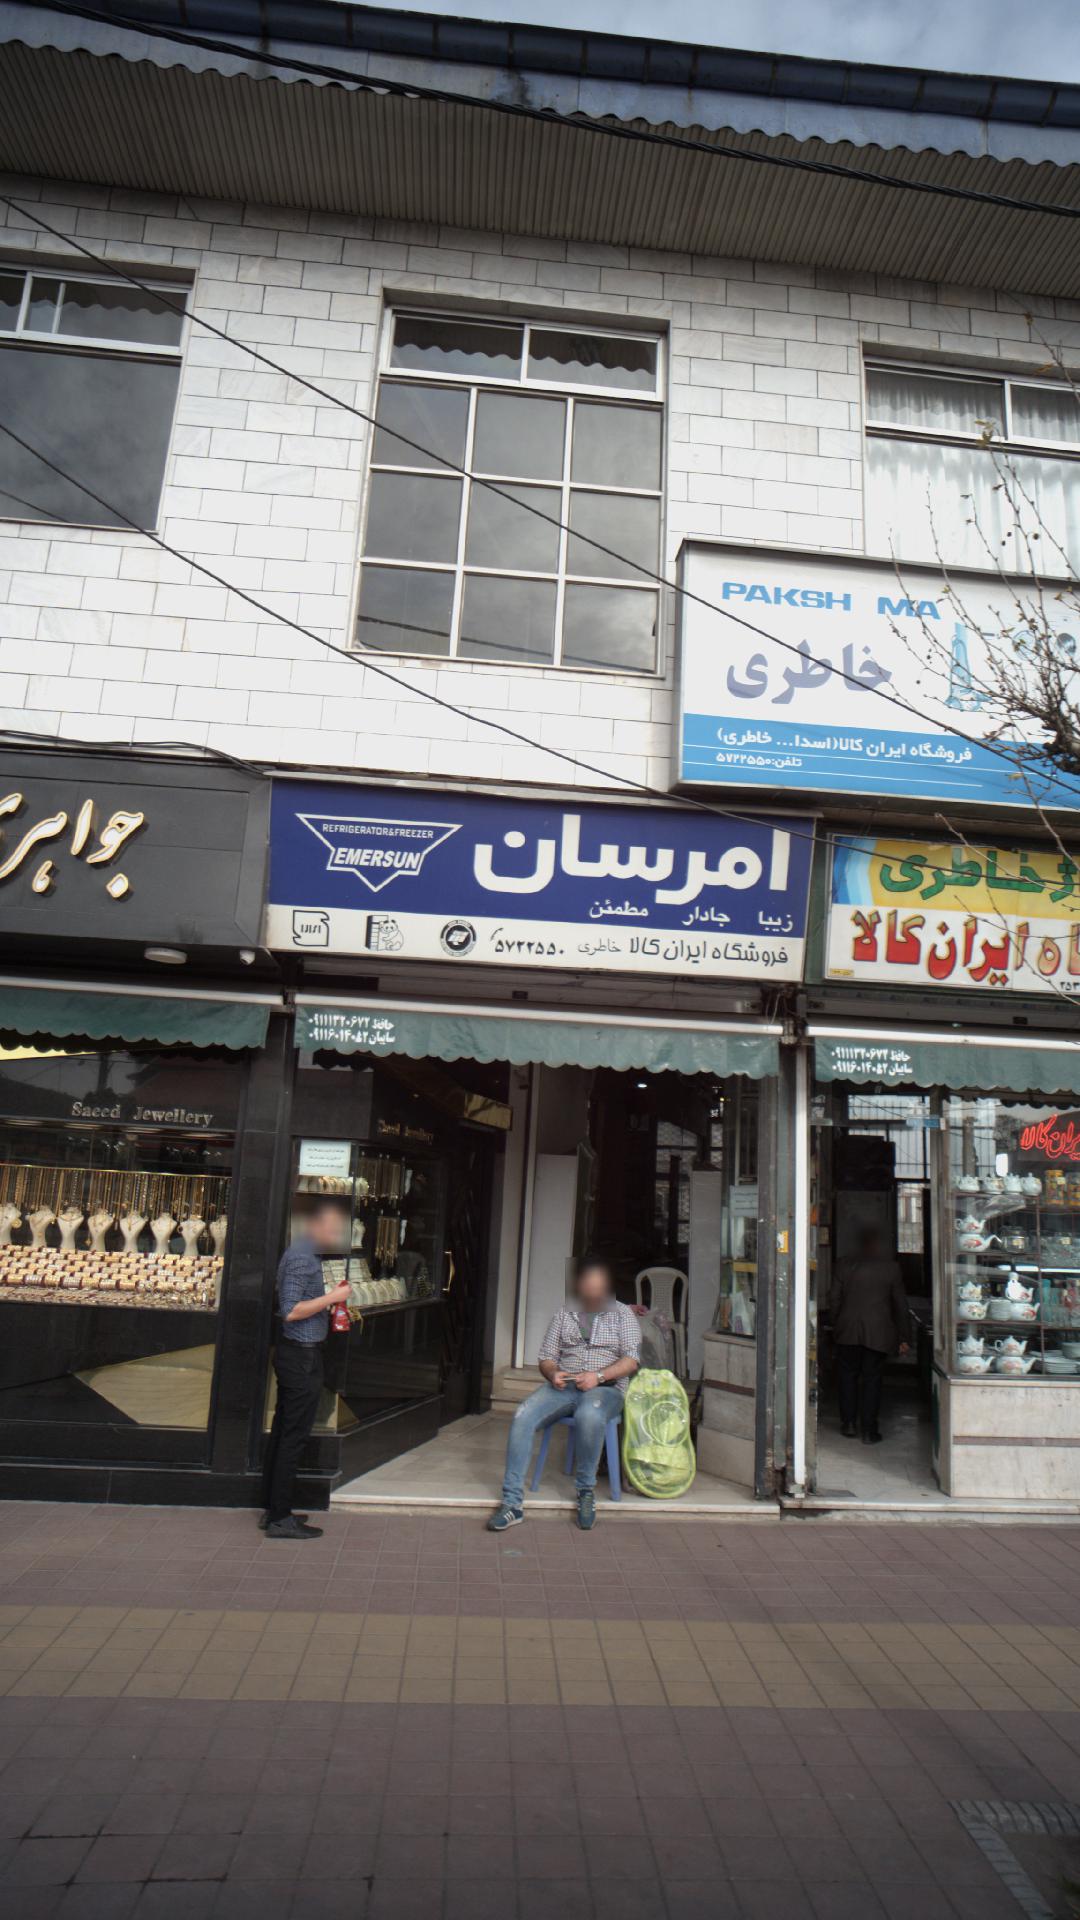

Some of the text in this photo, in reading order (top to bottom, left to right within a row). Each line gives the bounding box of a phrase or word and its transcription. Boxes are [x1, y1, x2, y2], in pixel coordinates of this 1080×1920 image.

[722, 582, 941, 620] PAKSH MA
[727, 639, 892, 704] خاطری
[866, 742, 905, 758] ایران
[910, 743, 972, 764] فروشگاه
[322, 823, 434, 839] REFRIGERATOR&FREEZER
[0, 792, 144, 898] جواهر
[334, 847, 420, 869] EMERSUN
[473, 814, 790, 905] امرسان
[880, 847, 1045, 901] خاطری
[589, 900, 793, 931] زیبا جادار مطمئن
[578, 938, 621, 955] خاطری
[630, 937, 660, 955] کالا
[851, 909, 925, 965] کالا
[926, 914, 1029, 986] ایران
[664, 940, 706, 963] ایران
[712, 941, 789, 967] فروشگاه
[71, 1101, 213, 1128] Saeed Jewellery
